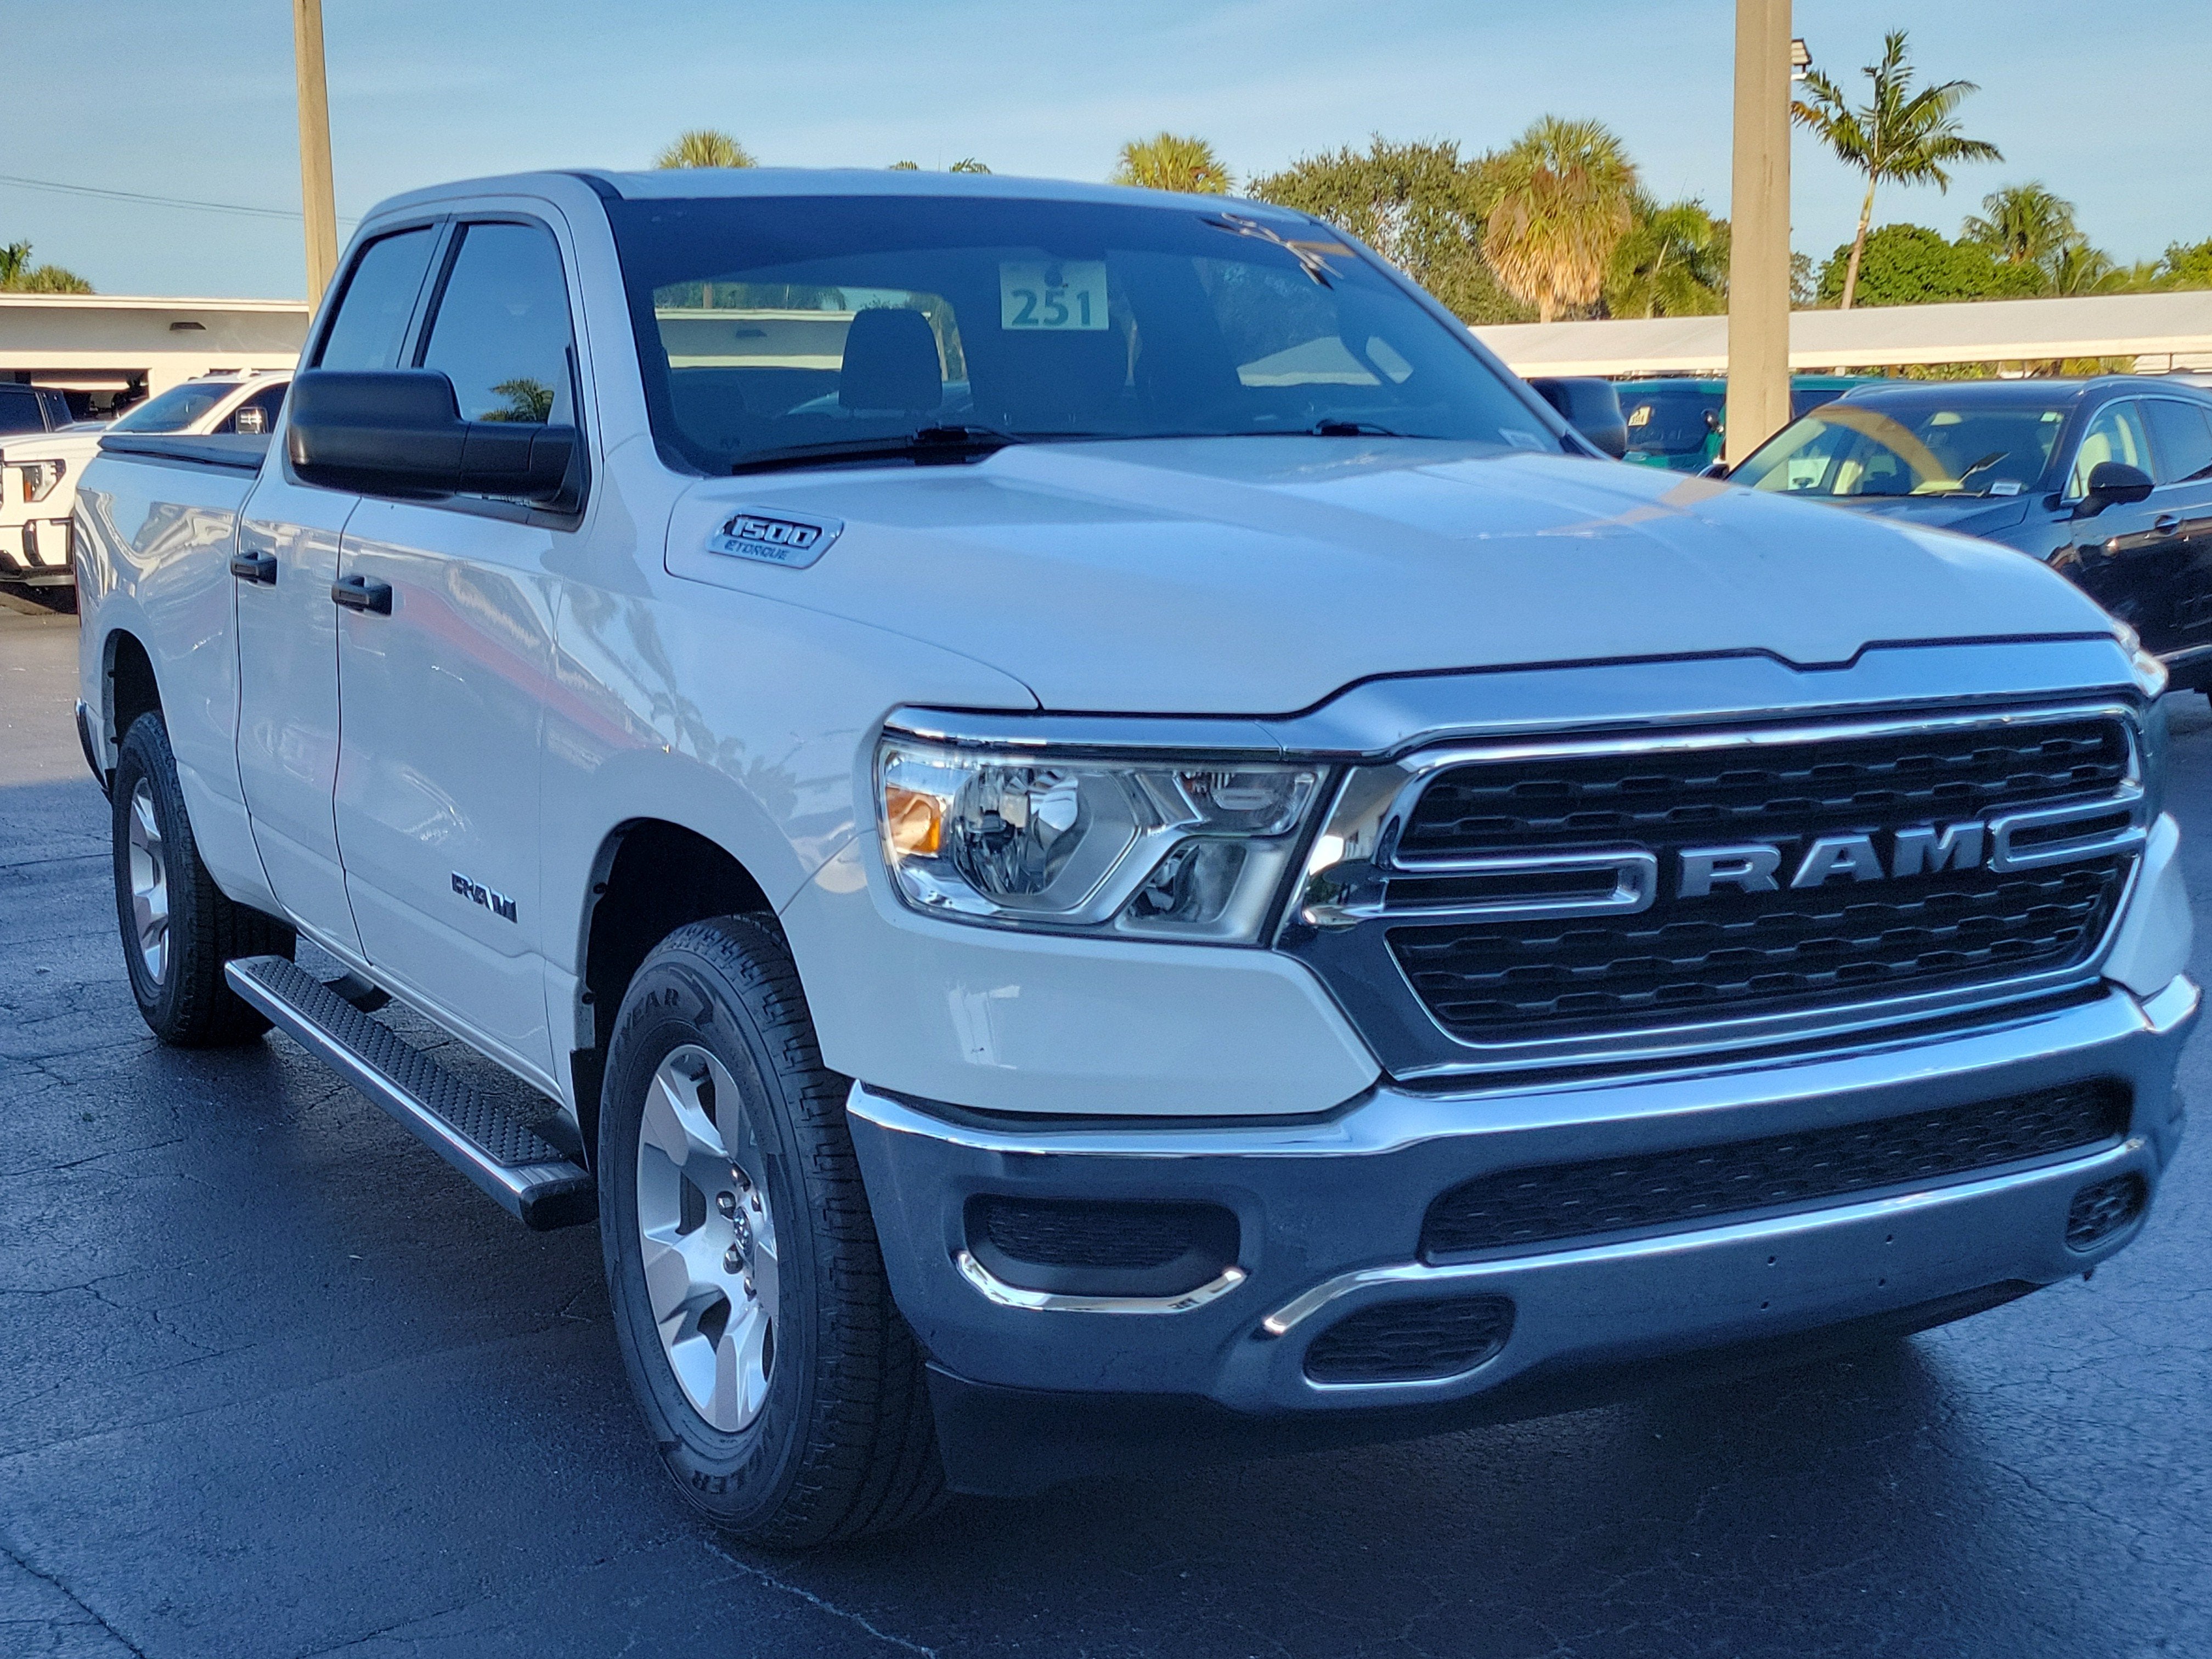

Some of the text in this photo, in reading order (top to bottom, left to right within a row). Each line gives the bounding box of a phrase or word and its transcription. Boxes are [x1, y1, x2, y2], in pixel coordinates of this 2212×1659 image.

[1011, 288, 1091, 327] 251
[731, 518, 817, 546] 1500
[1677, 821, 1984, 899] RAM
[451, 870, 518, 924] RAM
